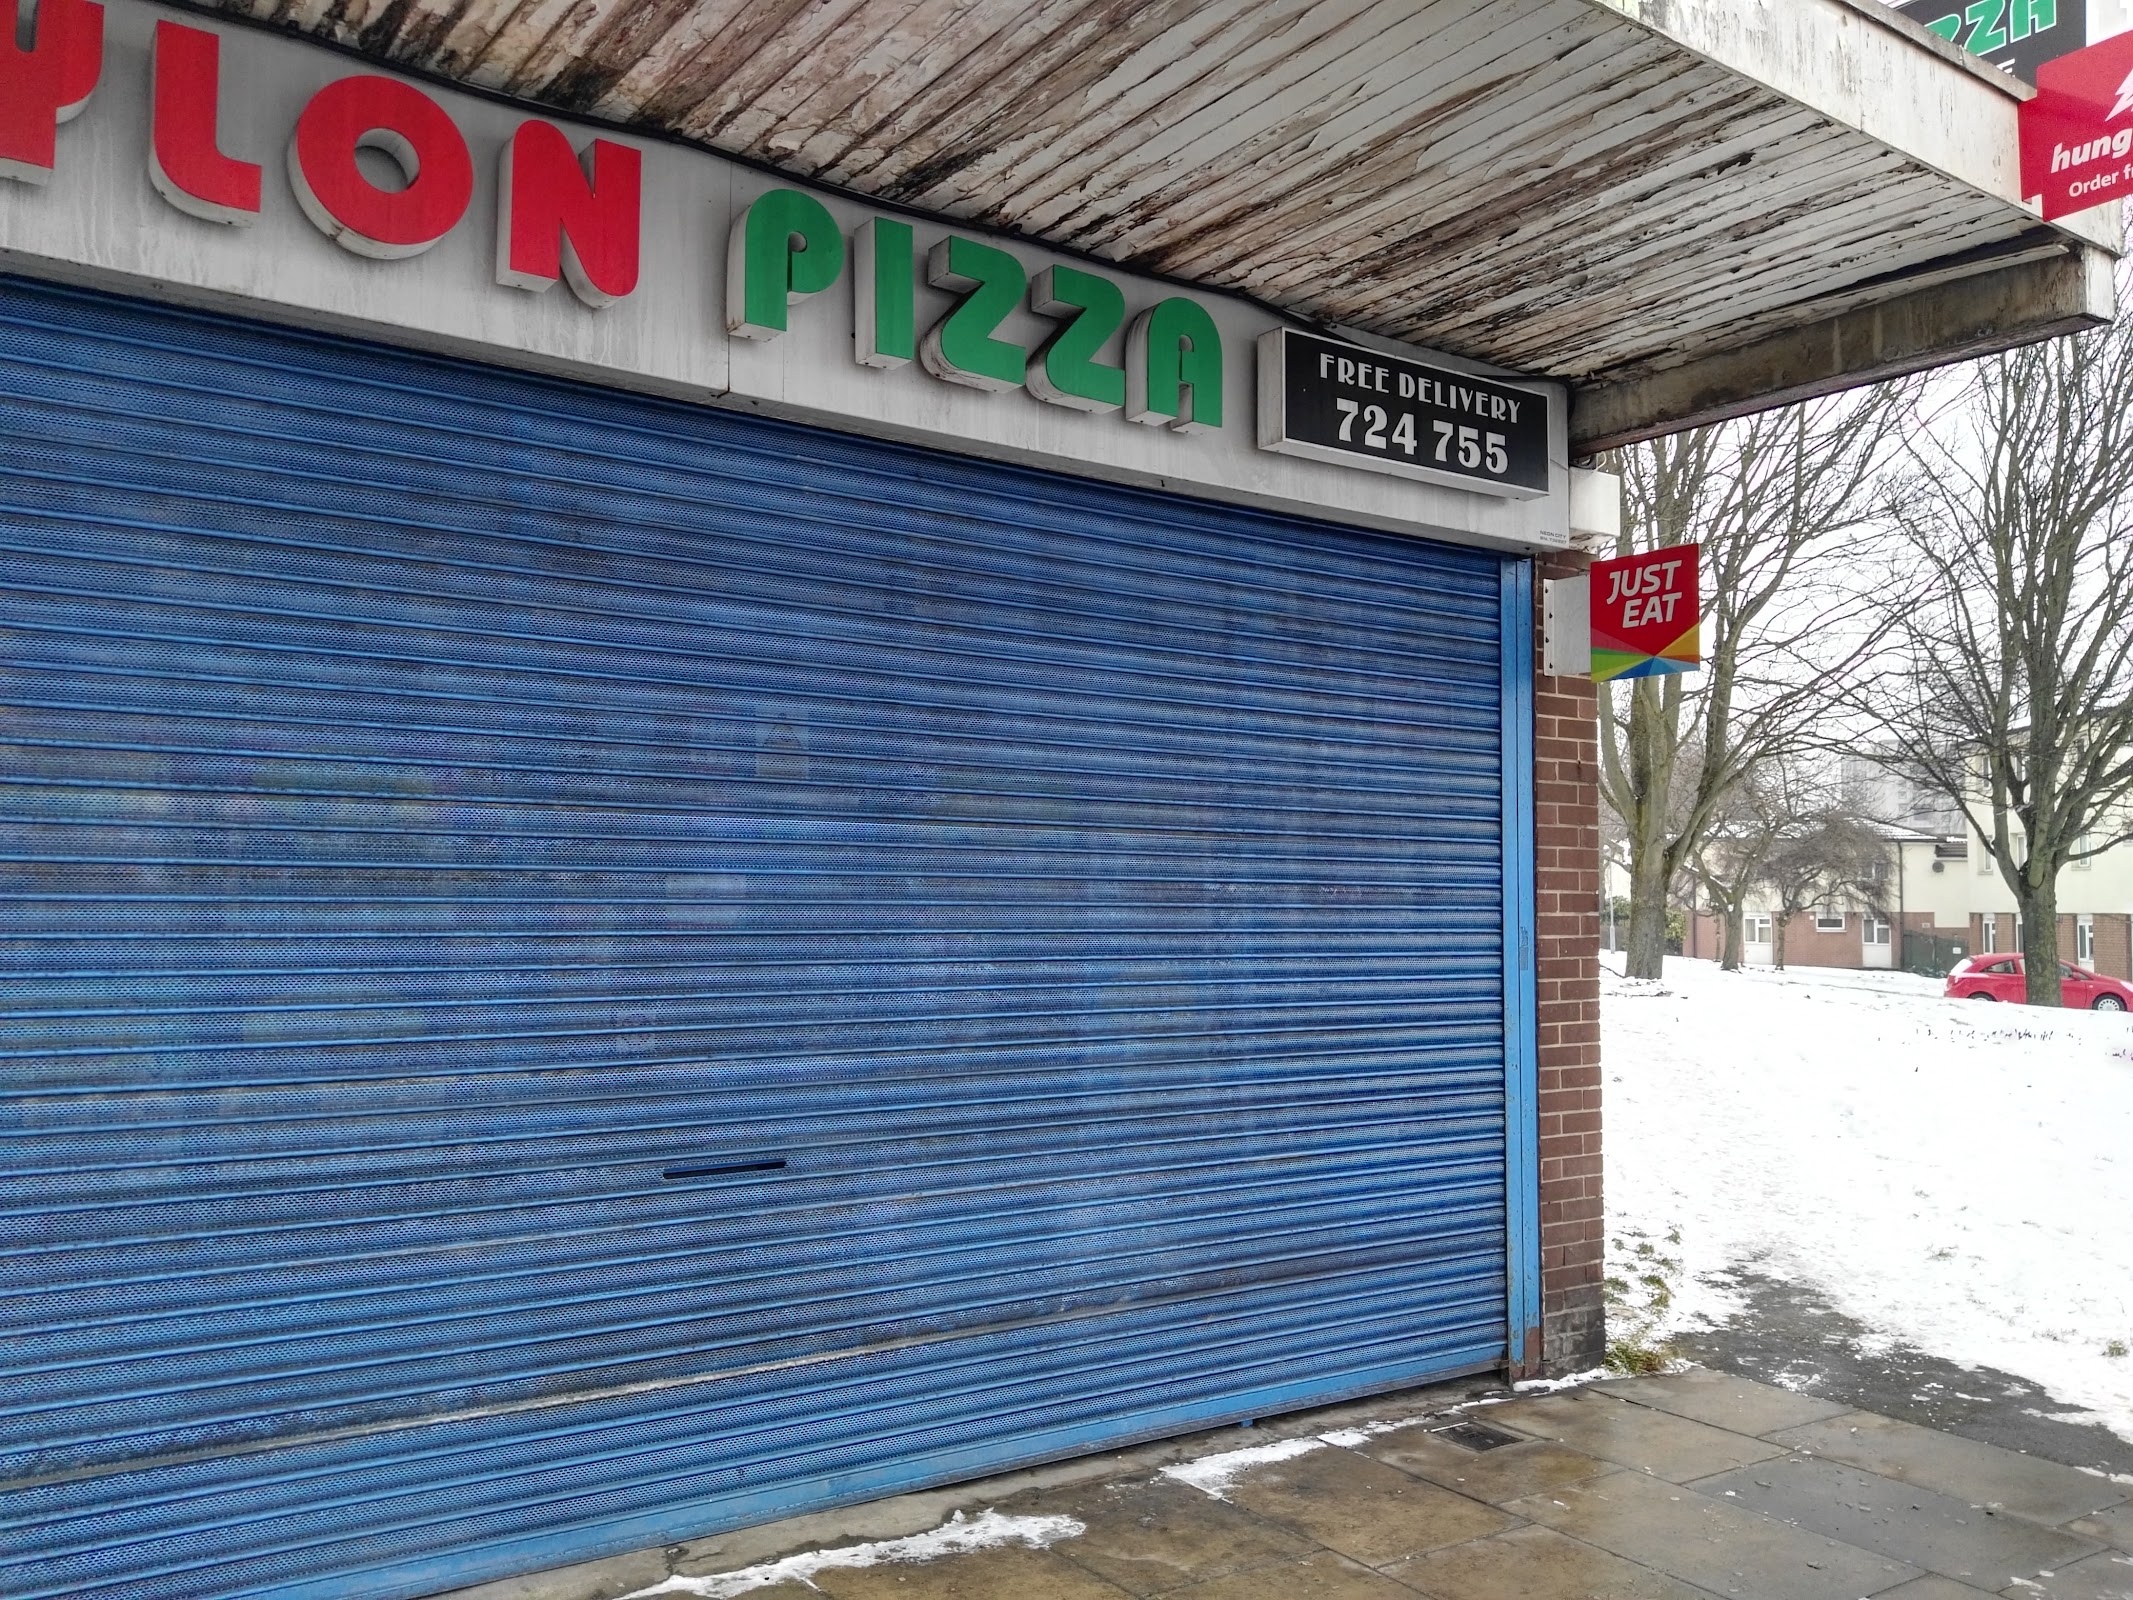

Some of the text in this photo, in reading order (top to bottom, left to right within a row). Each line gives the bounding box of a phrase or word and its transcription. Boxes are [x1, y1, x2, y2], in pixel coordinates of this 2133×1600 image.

[2069, 171, 2119, 197] Order
[728, 189, 1222, 431] PIZZA
[1319, 353, 1520, 423] FREE DELIVERY
[1336, 398, 1508, 474] 724 755
[1607, 560, 1682, 604] JUST
[1622, 592, 1682, 628] EAT
